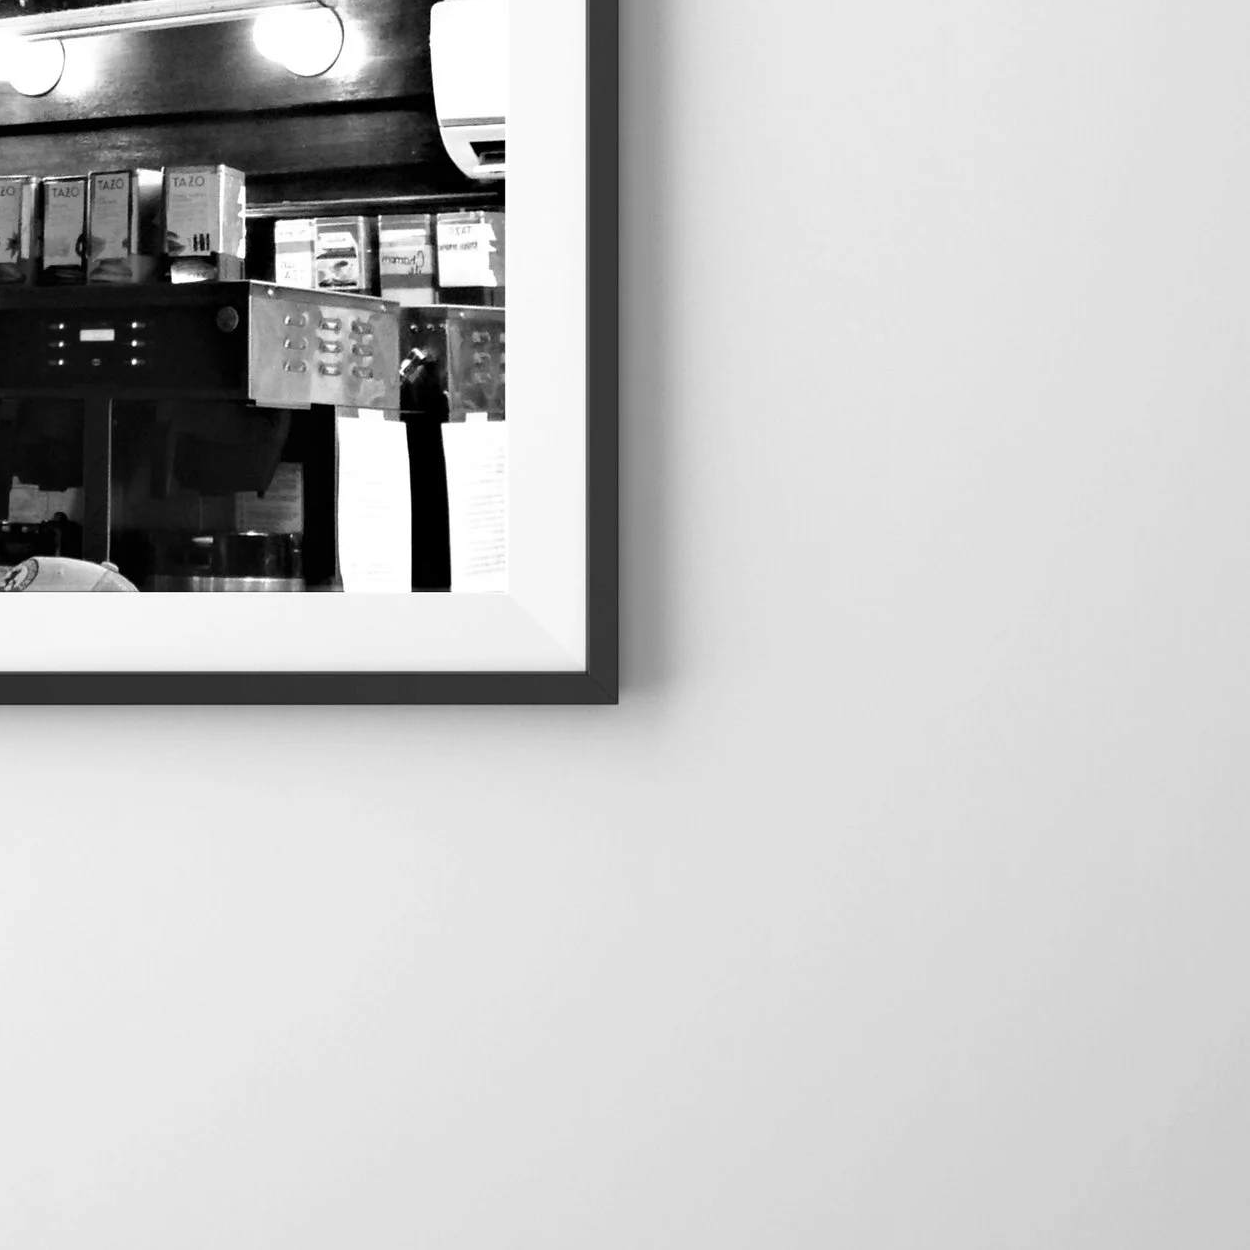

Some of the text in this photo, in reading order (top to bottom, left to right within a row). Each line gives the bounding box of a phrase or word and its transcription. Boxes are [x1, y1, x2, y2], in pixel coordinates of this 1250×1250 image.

[97, 178, 125, 191] TAZO
[171, 175, 206, 188] TAZO
[52, 186, 80, 199] TAZO
